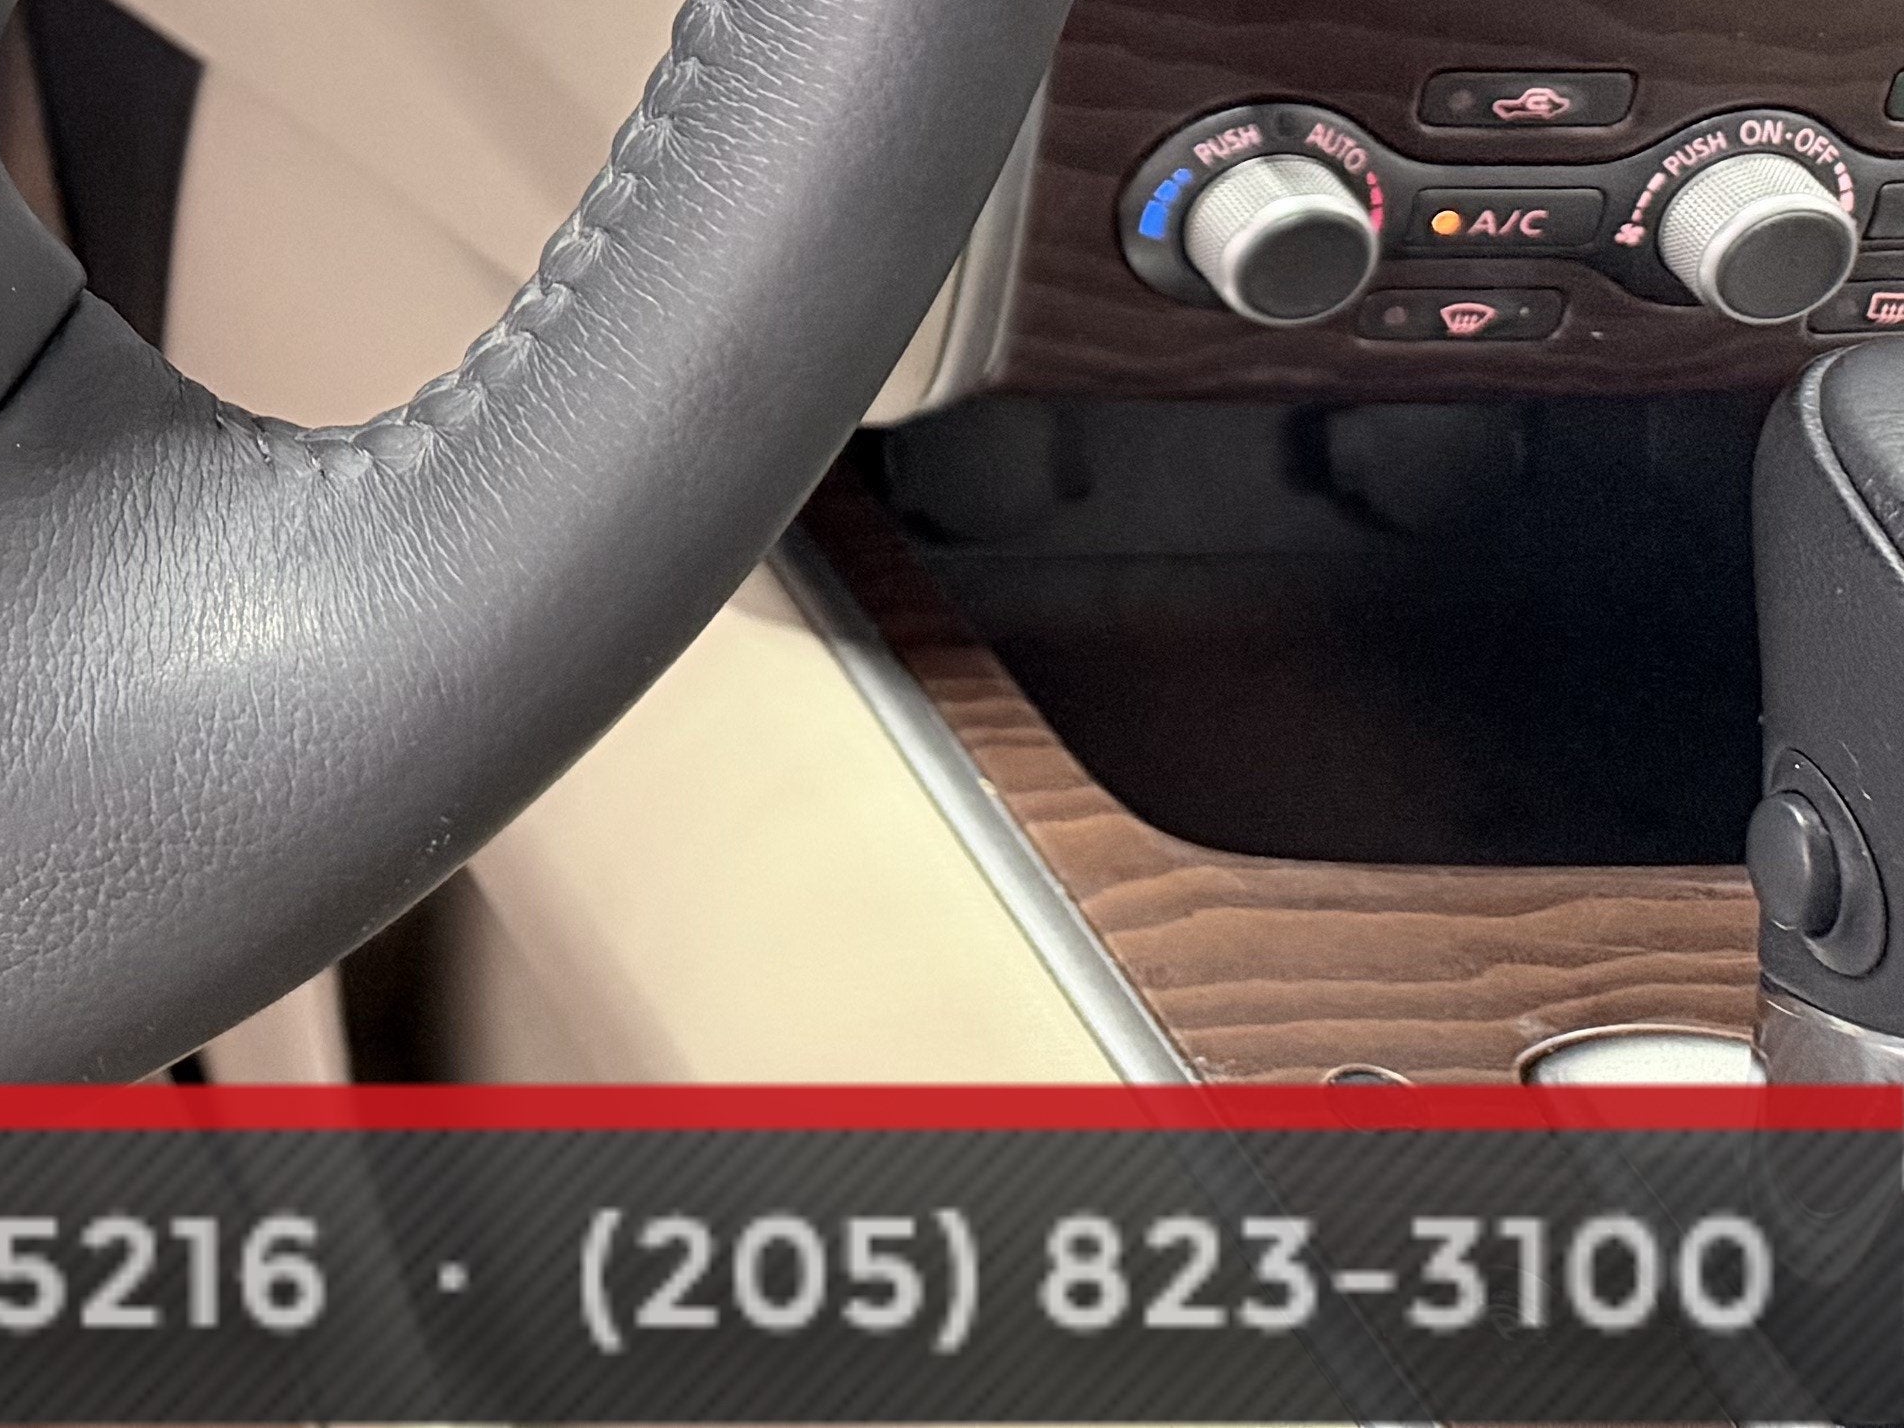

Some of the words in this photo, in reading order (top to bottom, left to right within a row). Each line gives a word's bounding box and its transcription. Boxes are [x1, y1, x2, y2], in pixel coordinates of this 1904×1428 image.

[1193, 123, 1264, 167] PUSH
[1304, 122, 1369, 175] AUTO
[1662, 130, 1728, 178] PUSH
[1467, 209, 1551, 238] A/C
